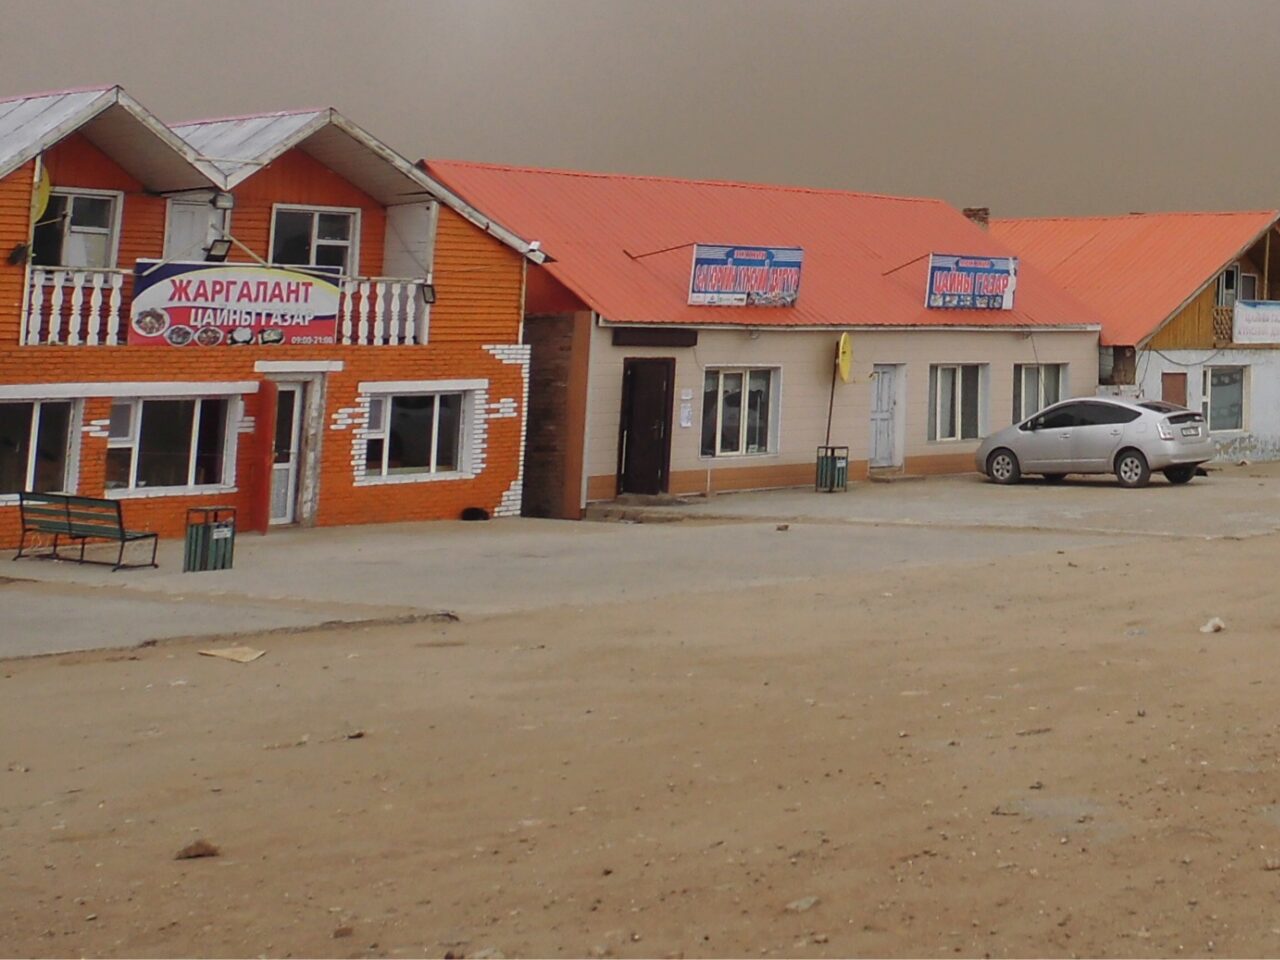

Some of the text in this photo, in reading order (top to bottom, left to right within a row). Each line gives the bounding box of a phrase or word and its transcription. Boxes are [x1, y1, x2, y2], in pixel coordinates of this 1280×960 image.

[168, 279, 313, 303] ЖАРГАЛАНТ
[933, 266, 1009, 296] ЦАЙНЫ ГАЗАР
[189, 306, 314, 328] ЦАЙНЫ ГАЗАР
